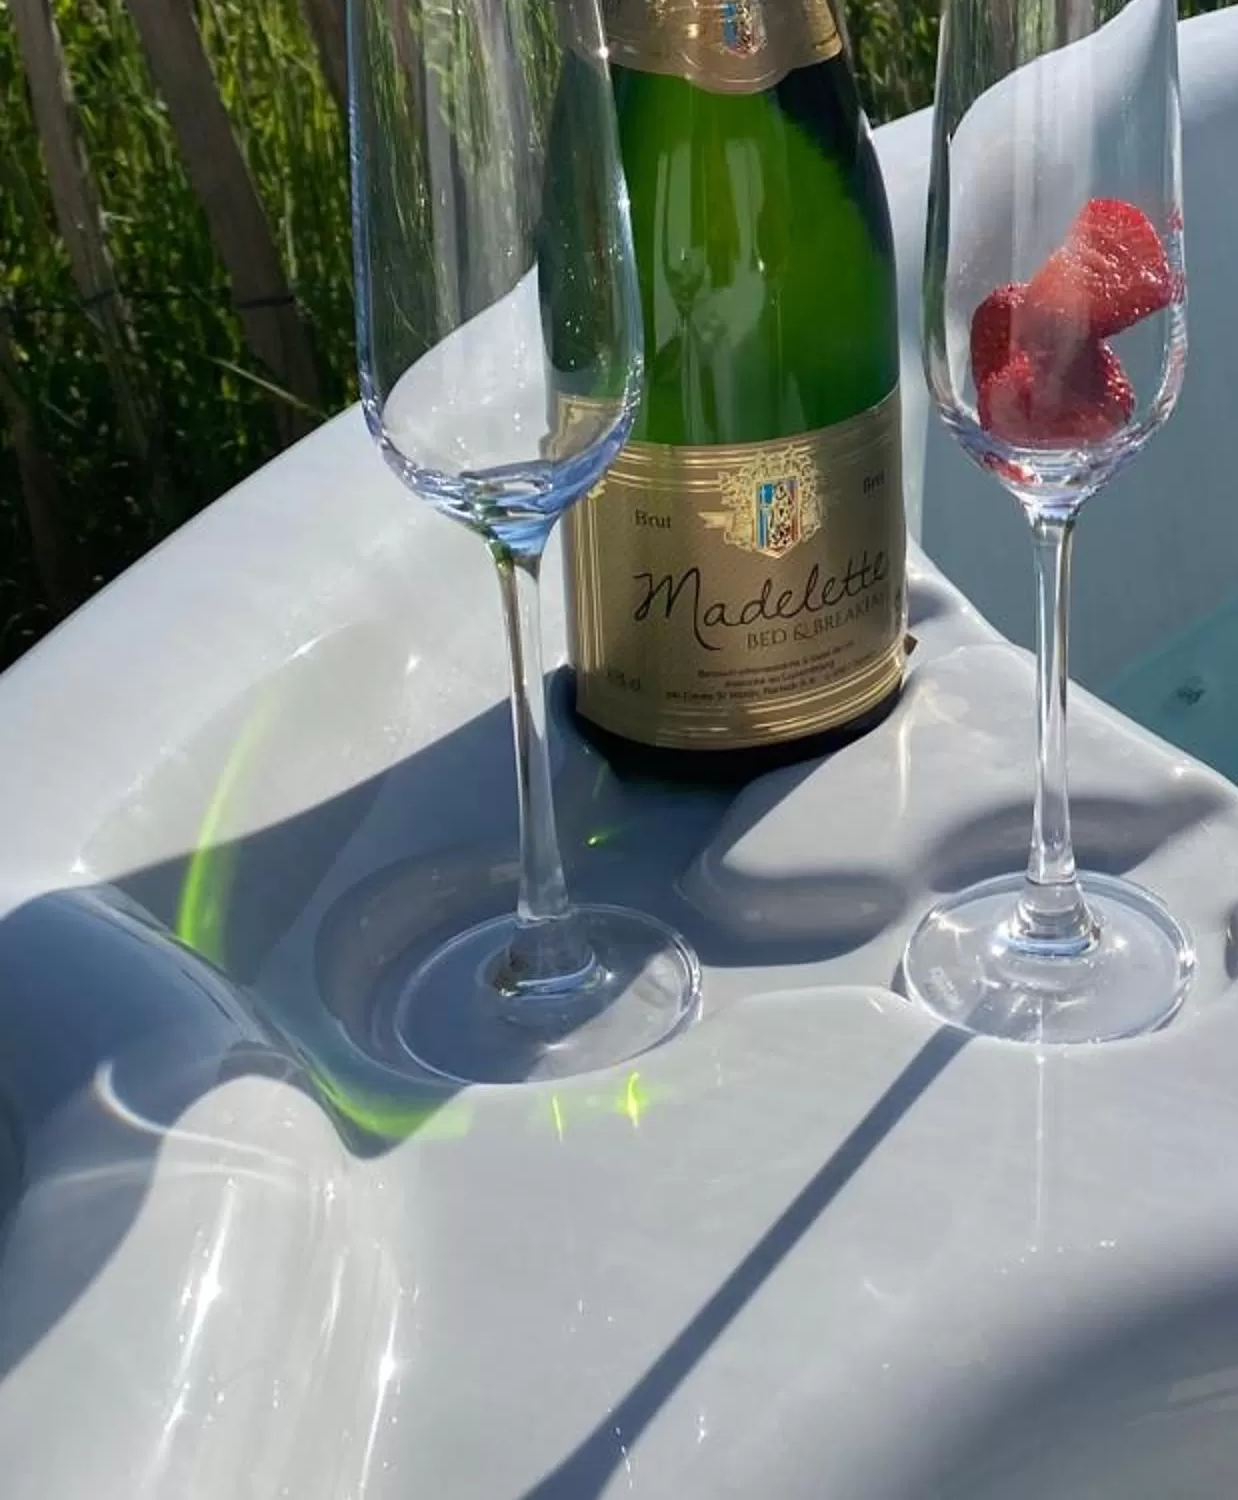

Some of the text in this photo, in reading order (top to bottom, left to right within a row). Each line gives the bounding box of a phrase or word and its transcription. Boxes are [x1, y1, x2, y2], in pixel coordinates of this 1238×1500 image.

[635, 508, 671, 529] Brut
[632, 550, 888, 651] Madelette
[747, 627, 787, 649] BED
